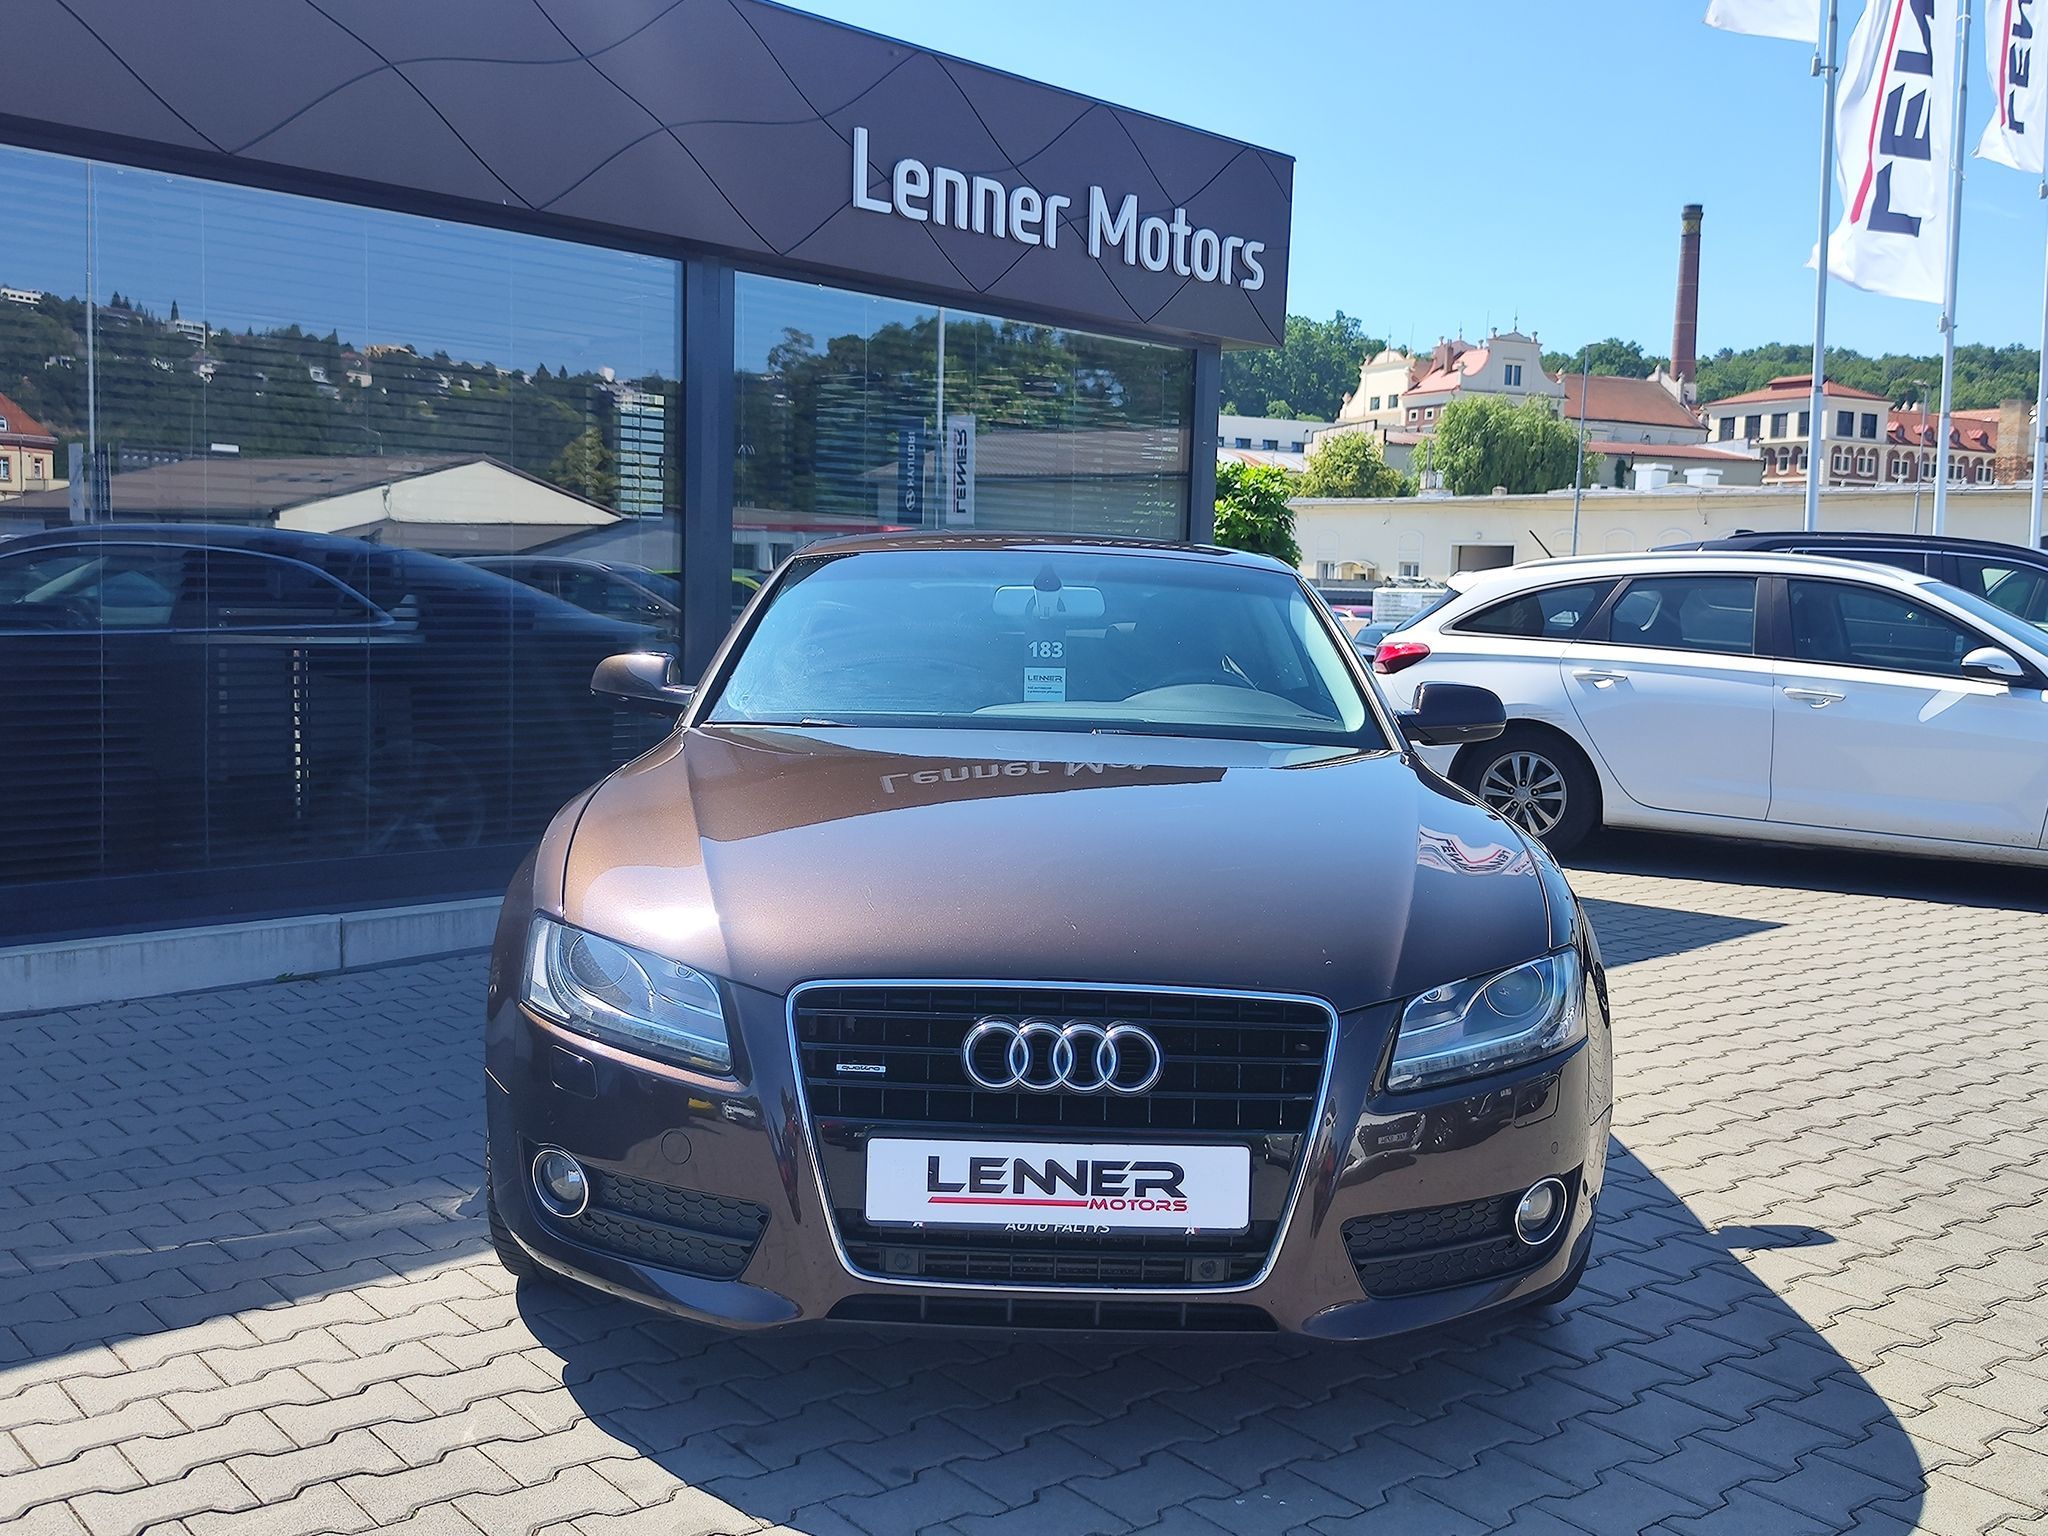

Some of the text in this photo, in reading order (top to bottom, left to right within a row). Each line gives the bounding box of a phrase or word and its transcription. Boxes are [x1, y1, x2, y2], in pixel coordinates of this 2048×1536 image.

[853, 127, 1265, 290] Lenner Motors
[1028, 641, 1063, 658] 183
[927, 1155, 1187, 1198] LENNER
[1088, 1199, 1188, 1212] MOTORS
[1004, 1222, 1048, 1232] AUTO
